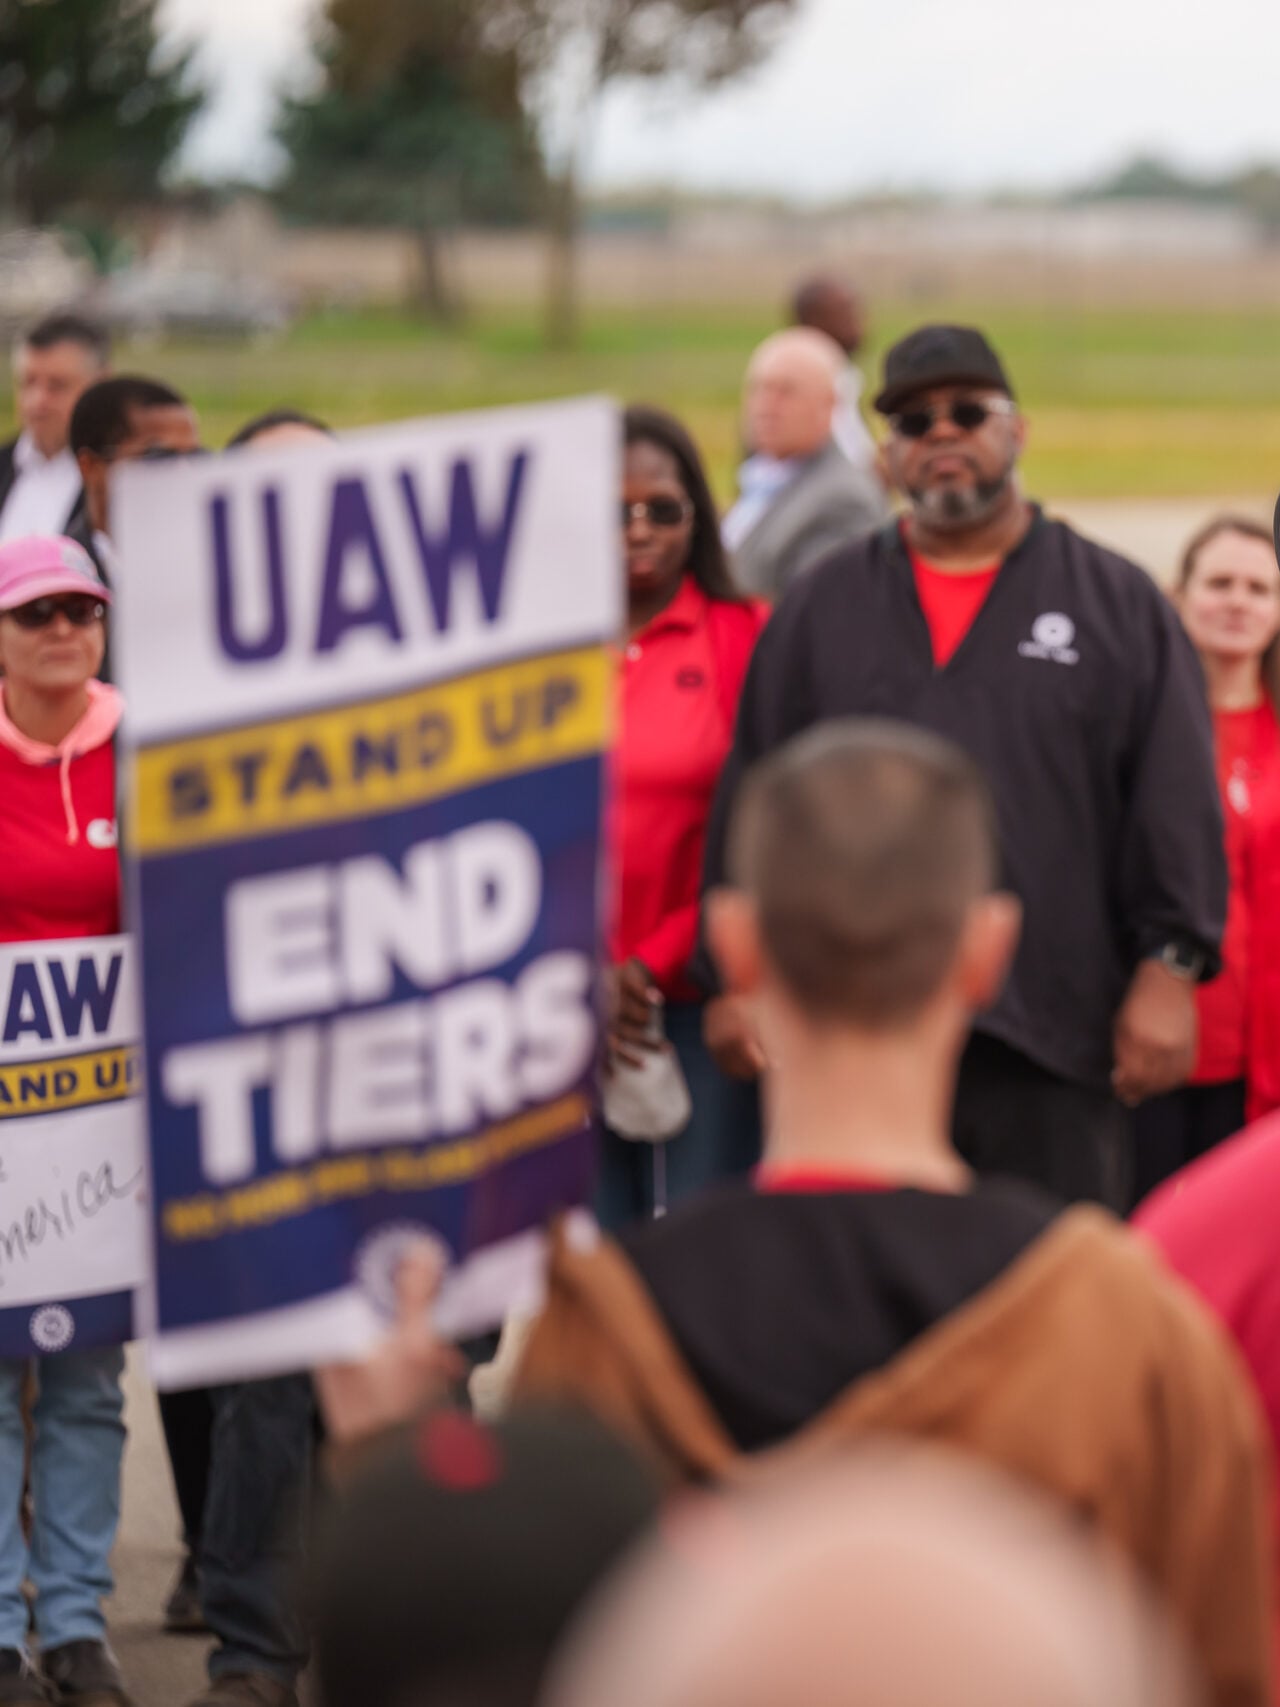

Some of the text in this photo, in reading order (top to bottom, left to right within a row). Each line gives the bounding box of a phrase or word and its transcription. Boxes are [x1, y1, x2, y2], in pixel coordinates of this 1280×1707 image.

[207, 446, 532, 666] UAW
[167, 674, 582, 820] STAND UP
[223, 818, 543, 1028] END
[162, 948, 597, 1184] TIERS
